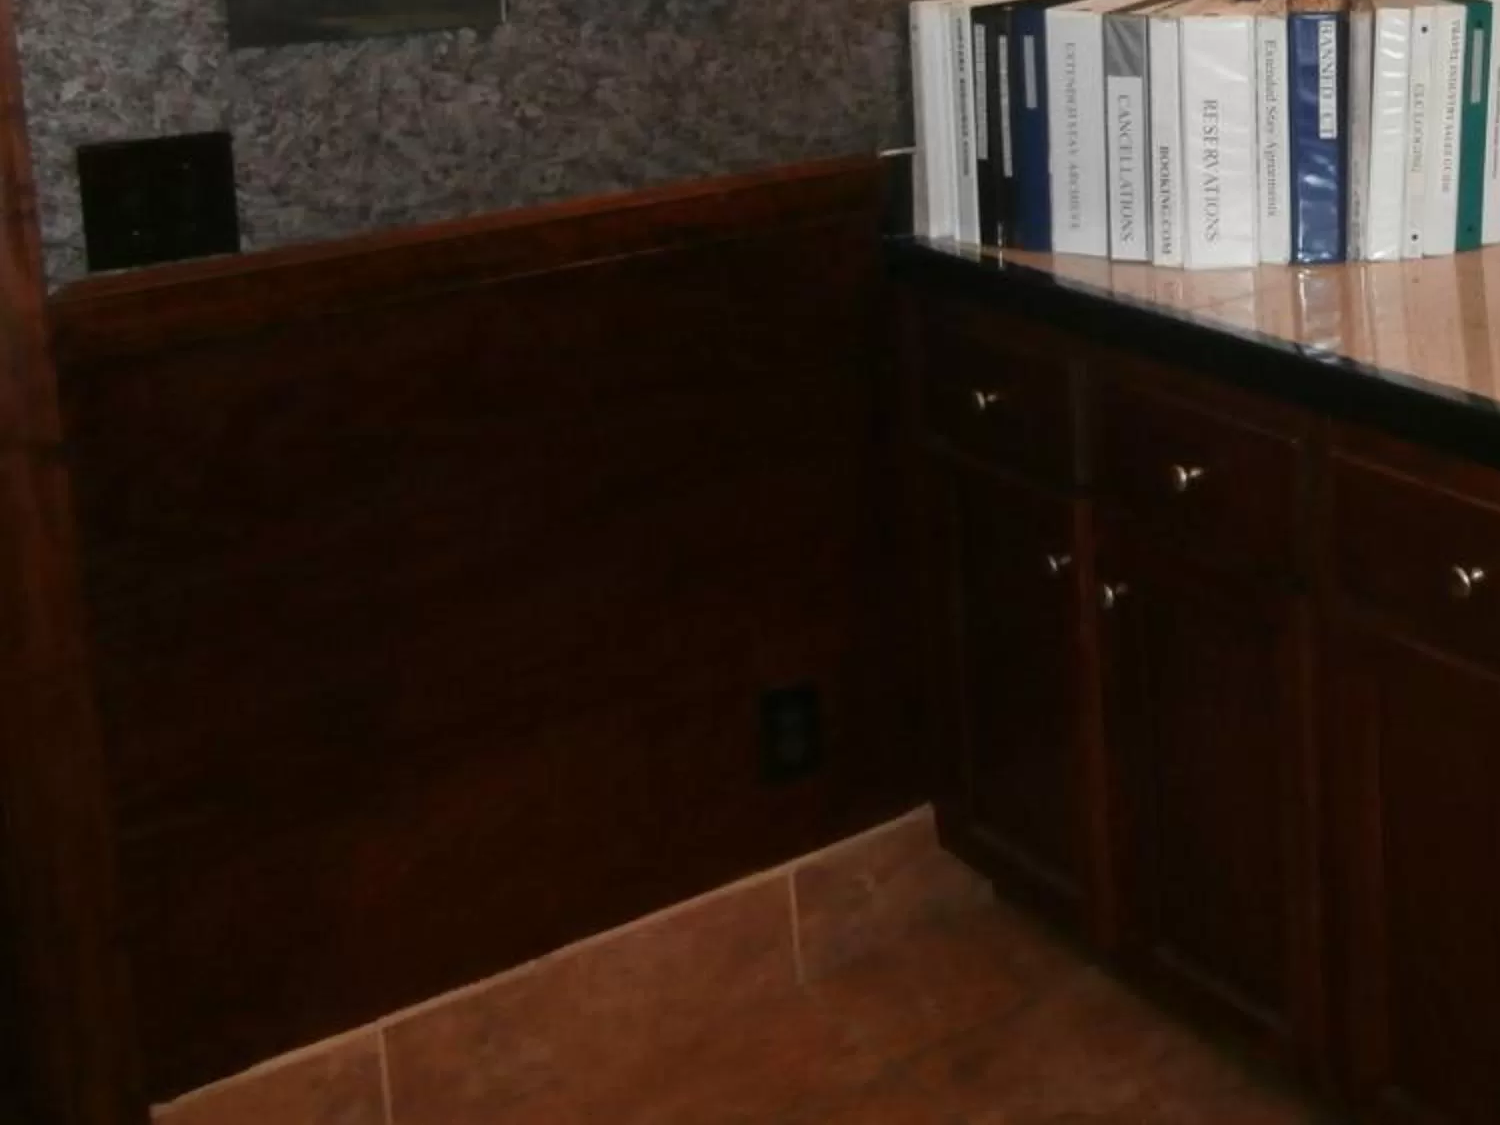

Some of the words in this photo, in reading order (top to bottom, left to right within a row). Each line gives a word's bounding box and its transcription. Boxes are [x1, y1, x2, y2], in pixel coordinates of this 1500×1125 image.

[1263, 39, 1279, 102] Extended
[1117, 93, 1135, 243] CANCELLATIONS
[1202, 99, 1221, 244] RESERVATIONS
